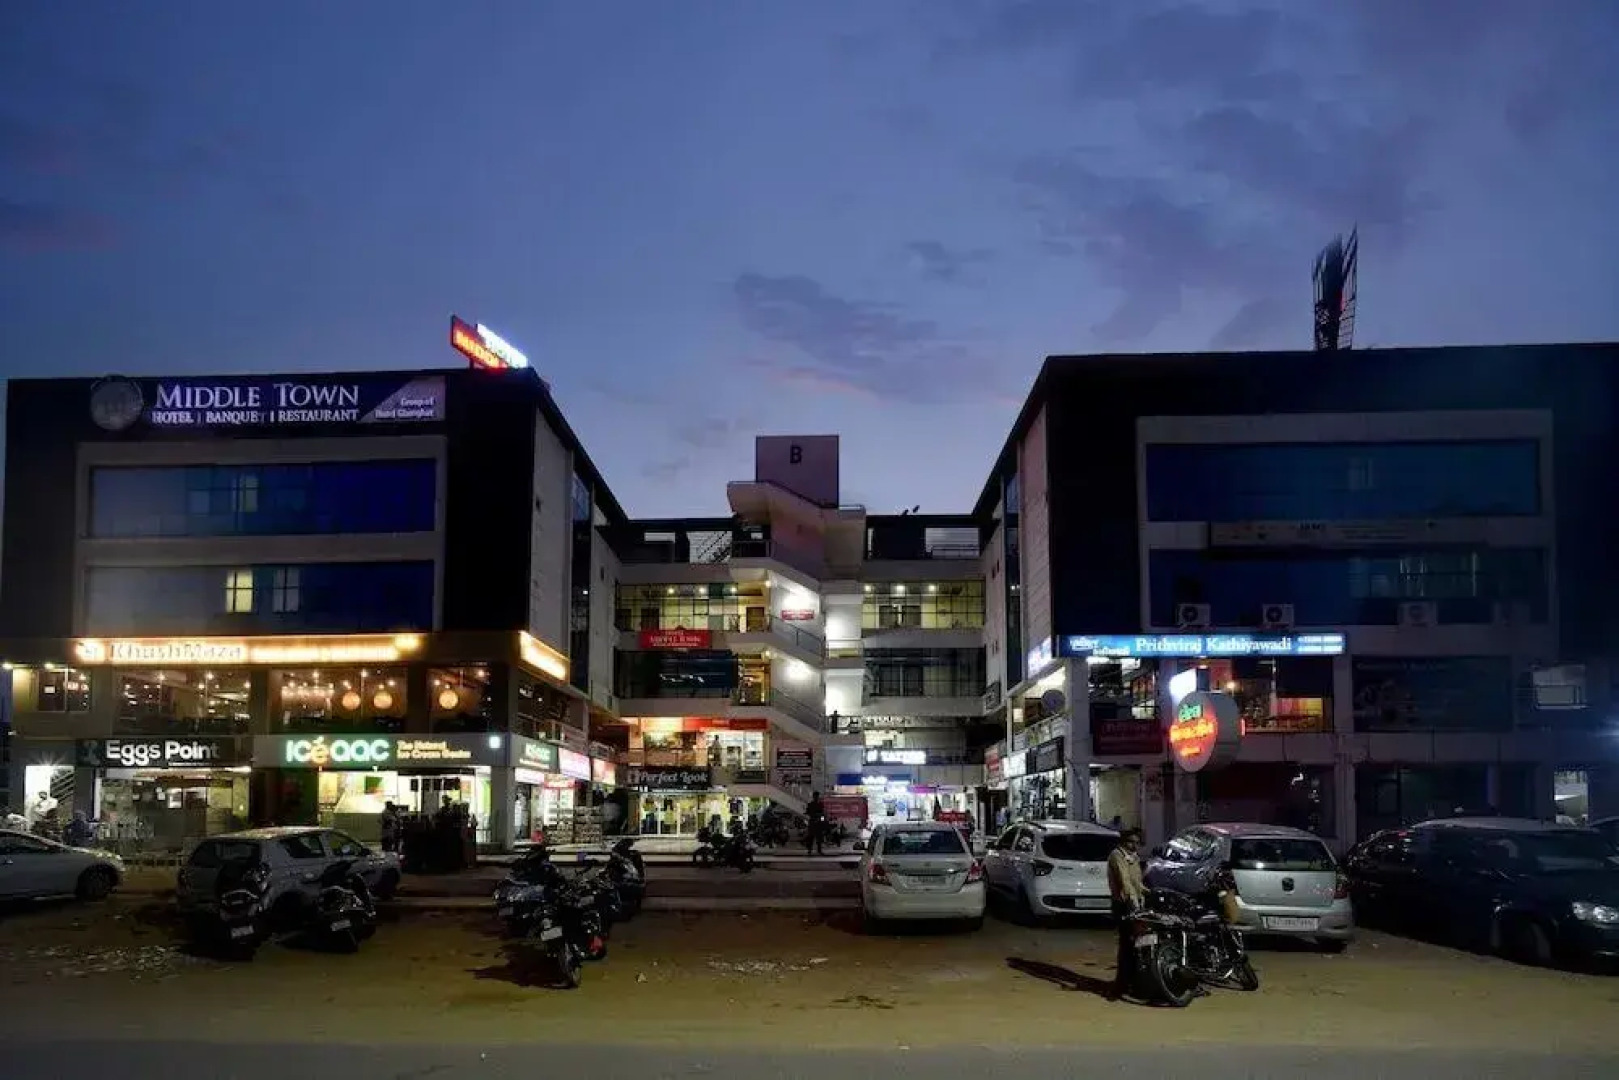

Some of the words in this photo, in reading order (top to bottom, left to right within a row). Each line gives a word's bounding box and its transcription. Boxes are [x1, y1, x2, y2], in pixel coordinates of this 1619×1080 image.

[154, 383, 261, 408] MIDDLE
[273, 382, 359, 407] TOWN
[152, 410, 195, 424] HOTEL
[206, 410, 266, 425] BANQUET
[278, 408, 360, 423] RESTAURANT
[789, 445, 803, 464] B
[1206, 635, 1292, 653] Kathiyawadi
[105, 739, 161, 767] Eggs
[164, 739, 221, 760] Point
[640, 770, 678, 785] Perfect
